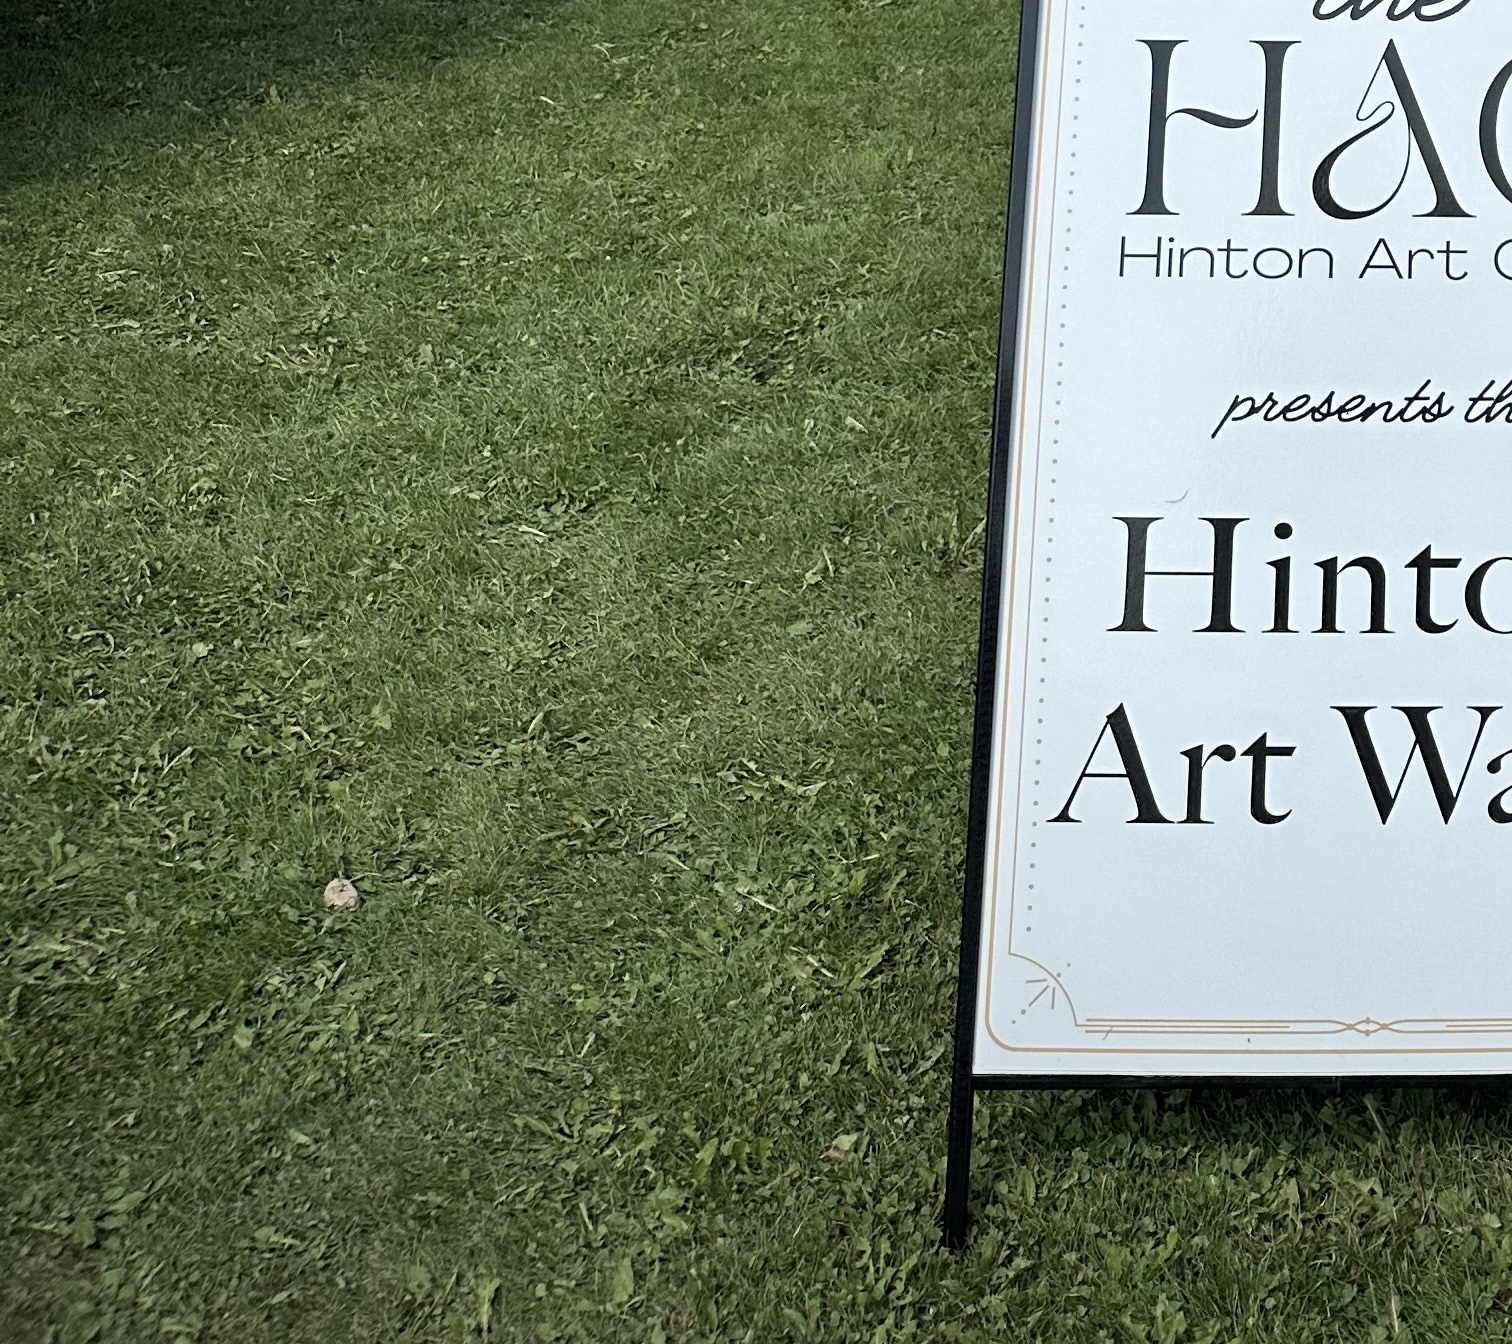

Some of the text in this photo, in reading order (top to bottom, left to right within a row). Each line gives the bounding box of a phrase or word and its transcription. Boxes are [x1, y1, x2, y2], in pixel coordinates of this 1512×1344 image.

[1119, 235, 1335, 280] Hinton
[1358, 237, 1469, 281] Art
[1210, 378, 1455, 439] presents
[1045, 702, 1297, 826] Art
